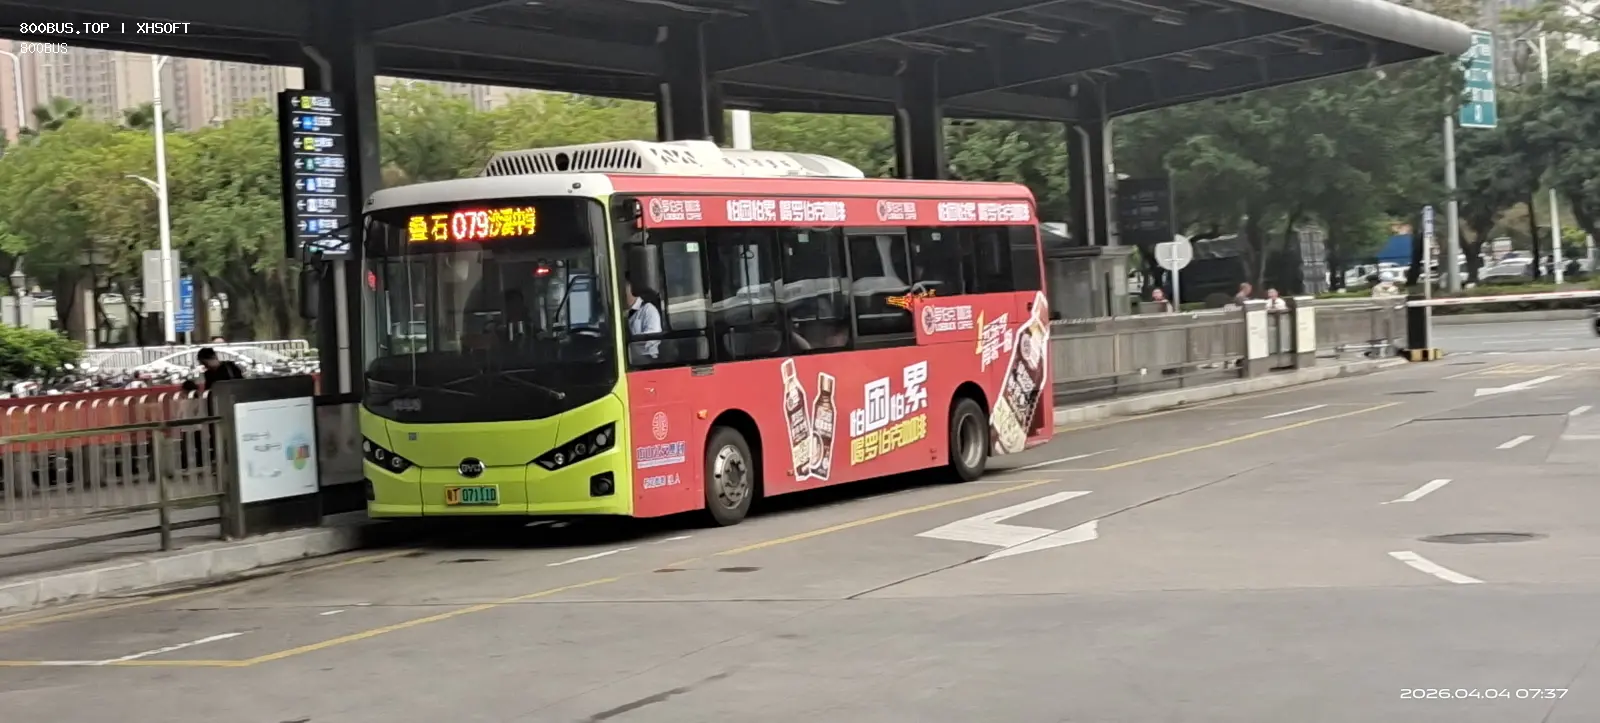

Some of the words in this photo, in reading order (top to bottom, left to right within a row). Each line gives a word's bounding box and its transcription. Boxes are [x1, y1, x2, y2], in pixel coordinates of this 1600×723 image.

[452, 210, 489, 240] 079
[850, 360, 928, 438] 怕困怕累
[850, 413, 927, 467] 喝罗伯克咖啡
[461, 463, 482, 473] BYD
